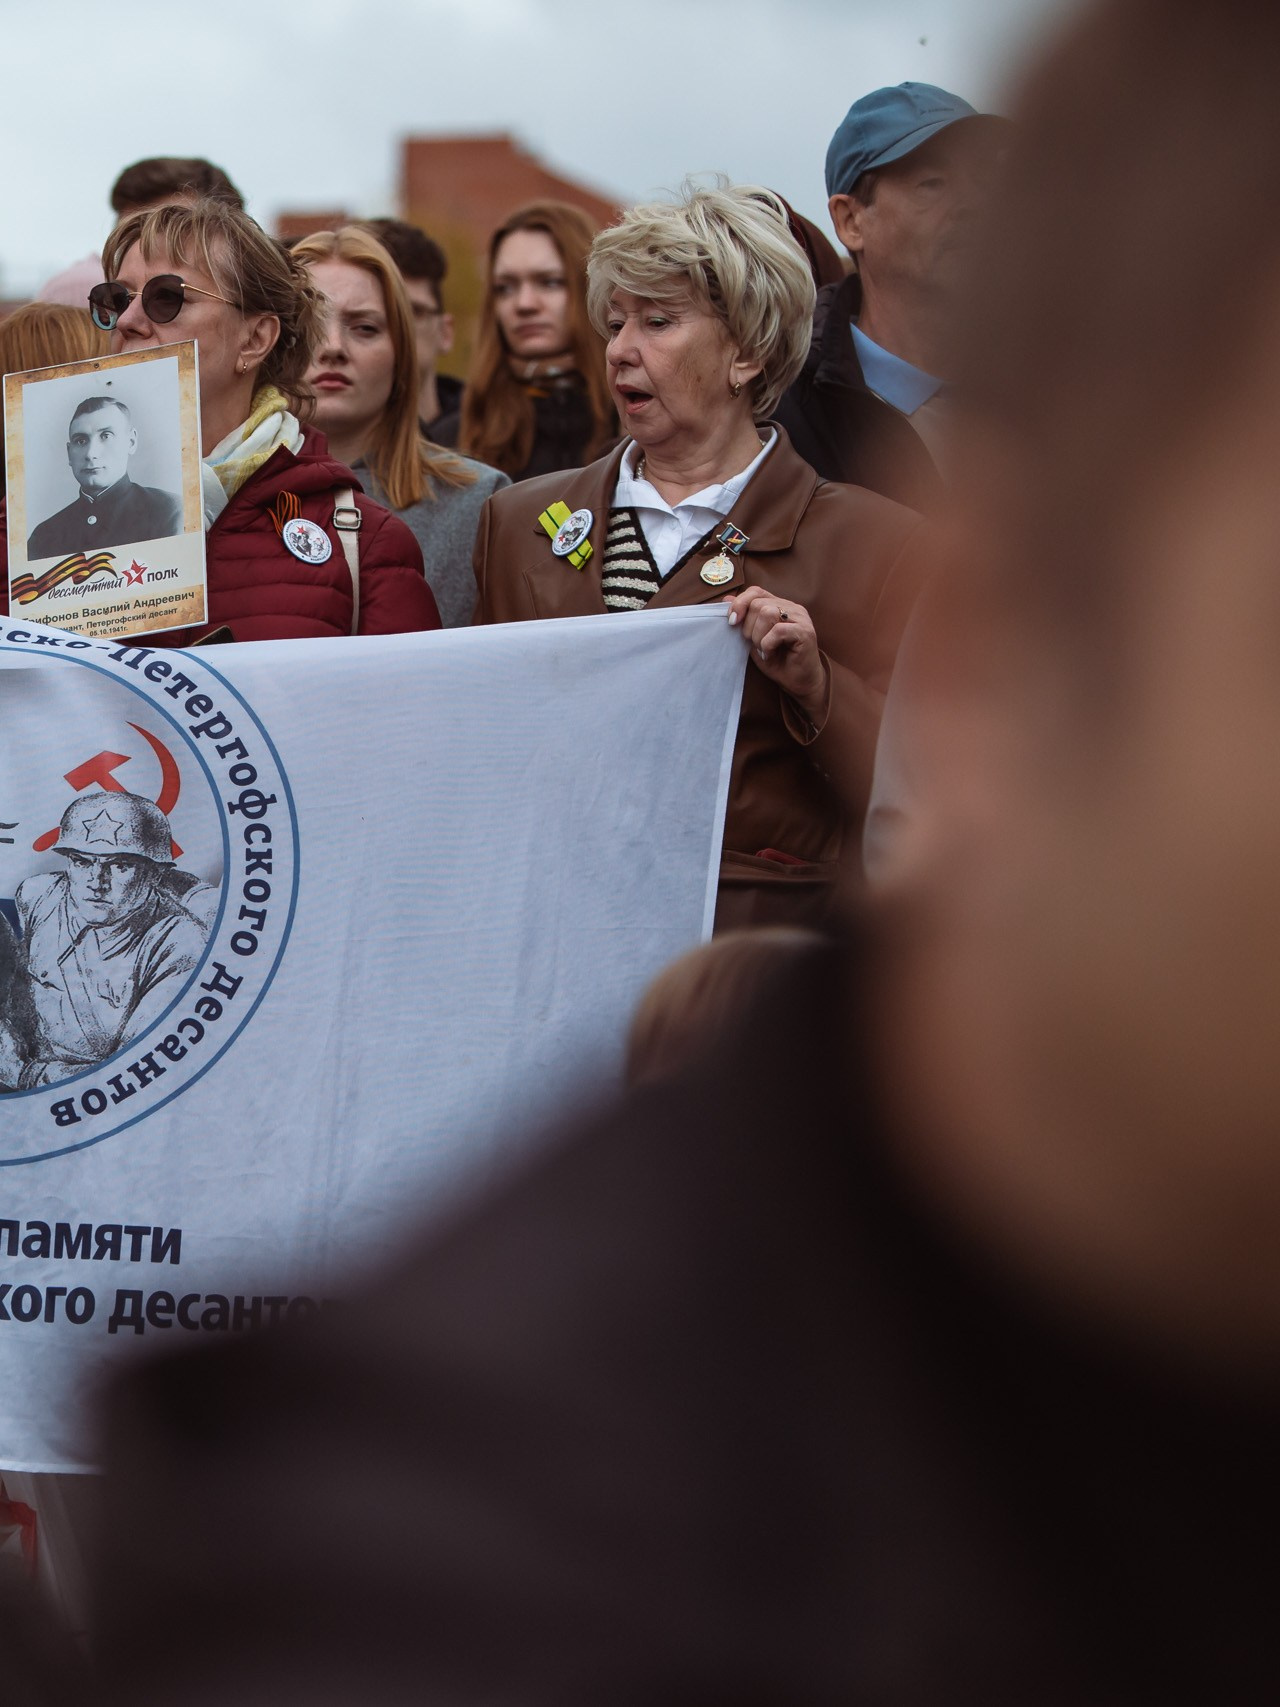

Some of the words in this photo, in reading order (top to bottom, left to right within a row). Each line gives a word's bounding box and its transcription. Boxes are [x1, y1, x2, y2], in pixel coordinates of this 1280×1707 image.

[48, 576, 125, 600] бессмертный
[82, 601, 131, 616] Василий
[133, 591, 195, 609] Андреевич
[86, 614, 147, 629] Петергофский
[148, 607, 178, 619] десант
[50, 961, 244, 1128] десантов
